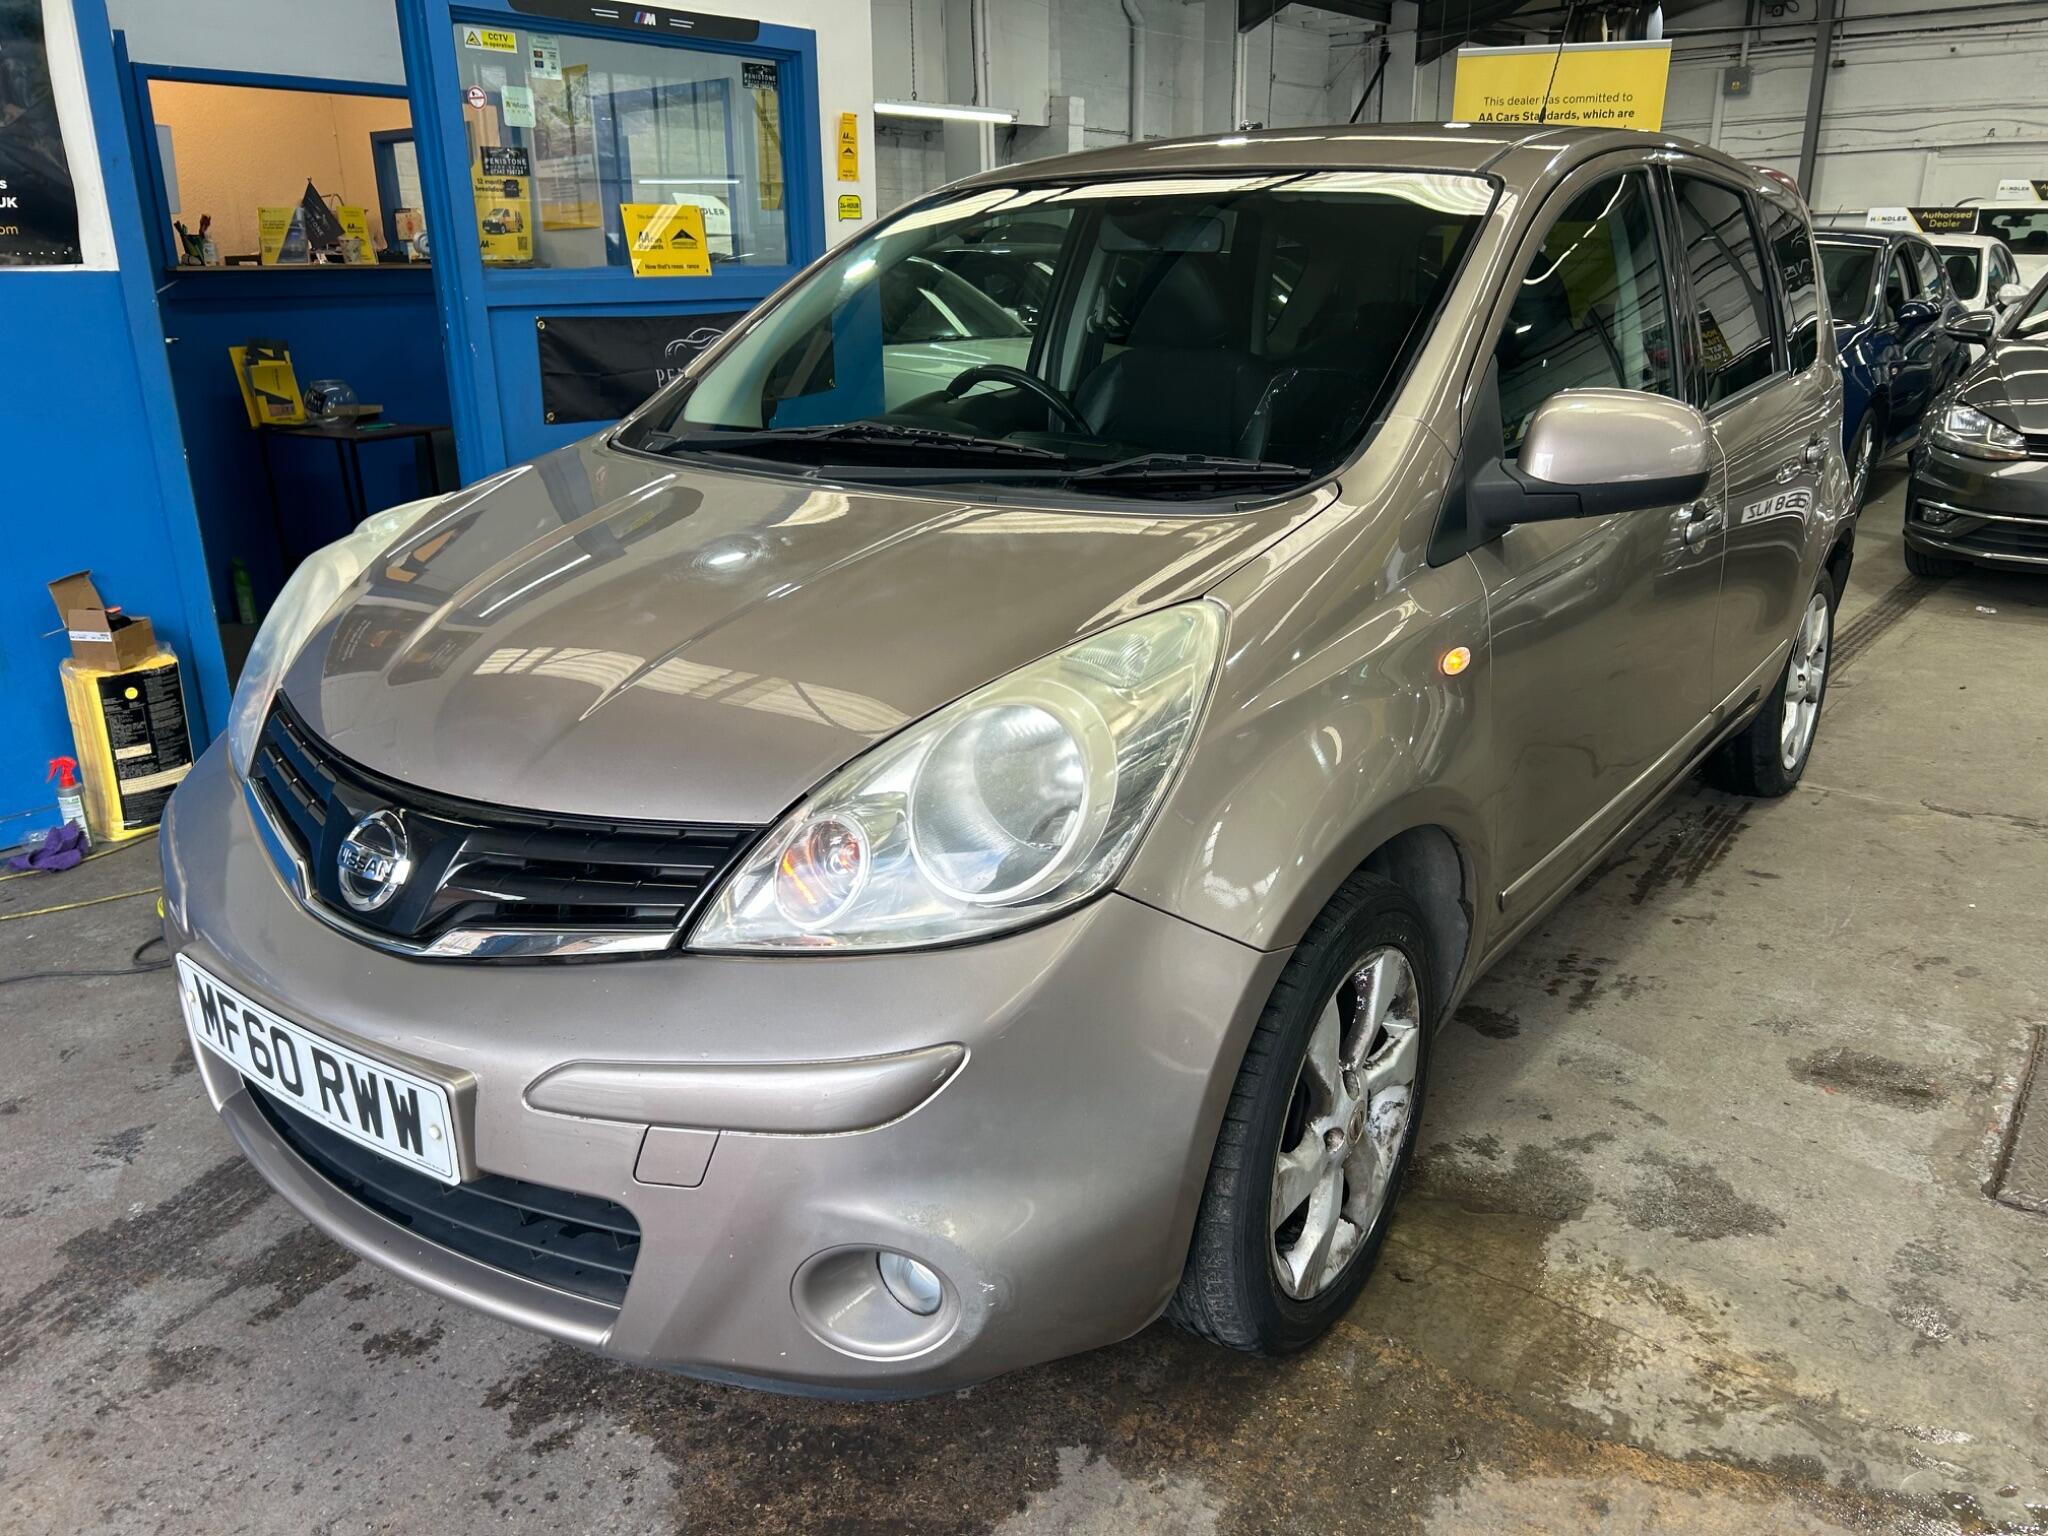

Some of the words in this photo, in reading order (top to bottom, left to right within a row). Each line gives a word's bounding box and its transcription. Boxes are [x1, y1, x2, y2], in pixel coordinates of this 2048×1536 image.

[488, 33, 508, 41] CCTV
[744, 73, 776, 82] PENISTONE
[1484, 96, 1505, 106] This
[1507, 95, 1540, 106] dealer
[1562, 93, 1620, 105] committed
[1621, 93, 1633, 103] to
[1478, 112, 1493, 122] AA
[1496, 112, 1520, 122] Cars
[1522, 110, 1580, 121] Stadards,
[1583, 109, 1614, 120] which
[1617, 110, 1635, 118] are
[485, 158, 527, 166] PENISTONE
[1921, 210, 1973, 220] Authorised
[1929, 219, 1960, 228] Dealer
[193, 973, 305, 1098] MF60
[310, 1045, 424, 1157] RWW
